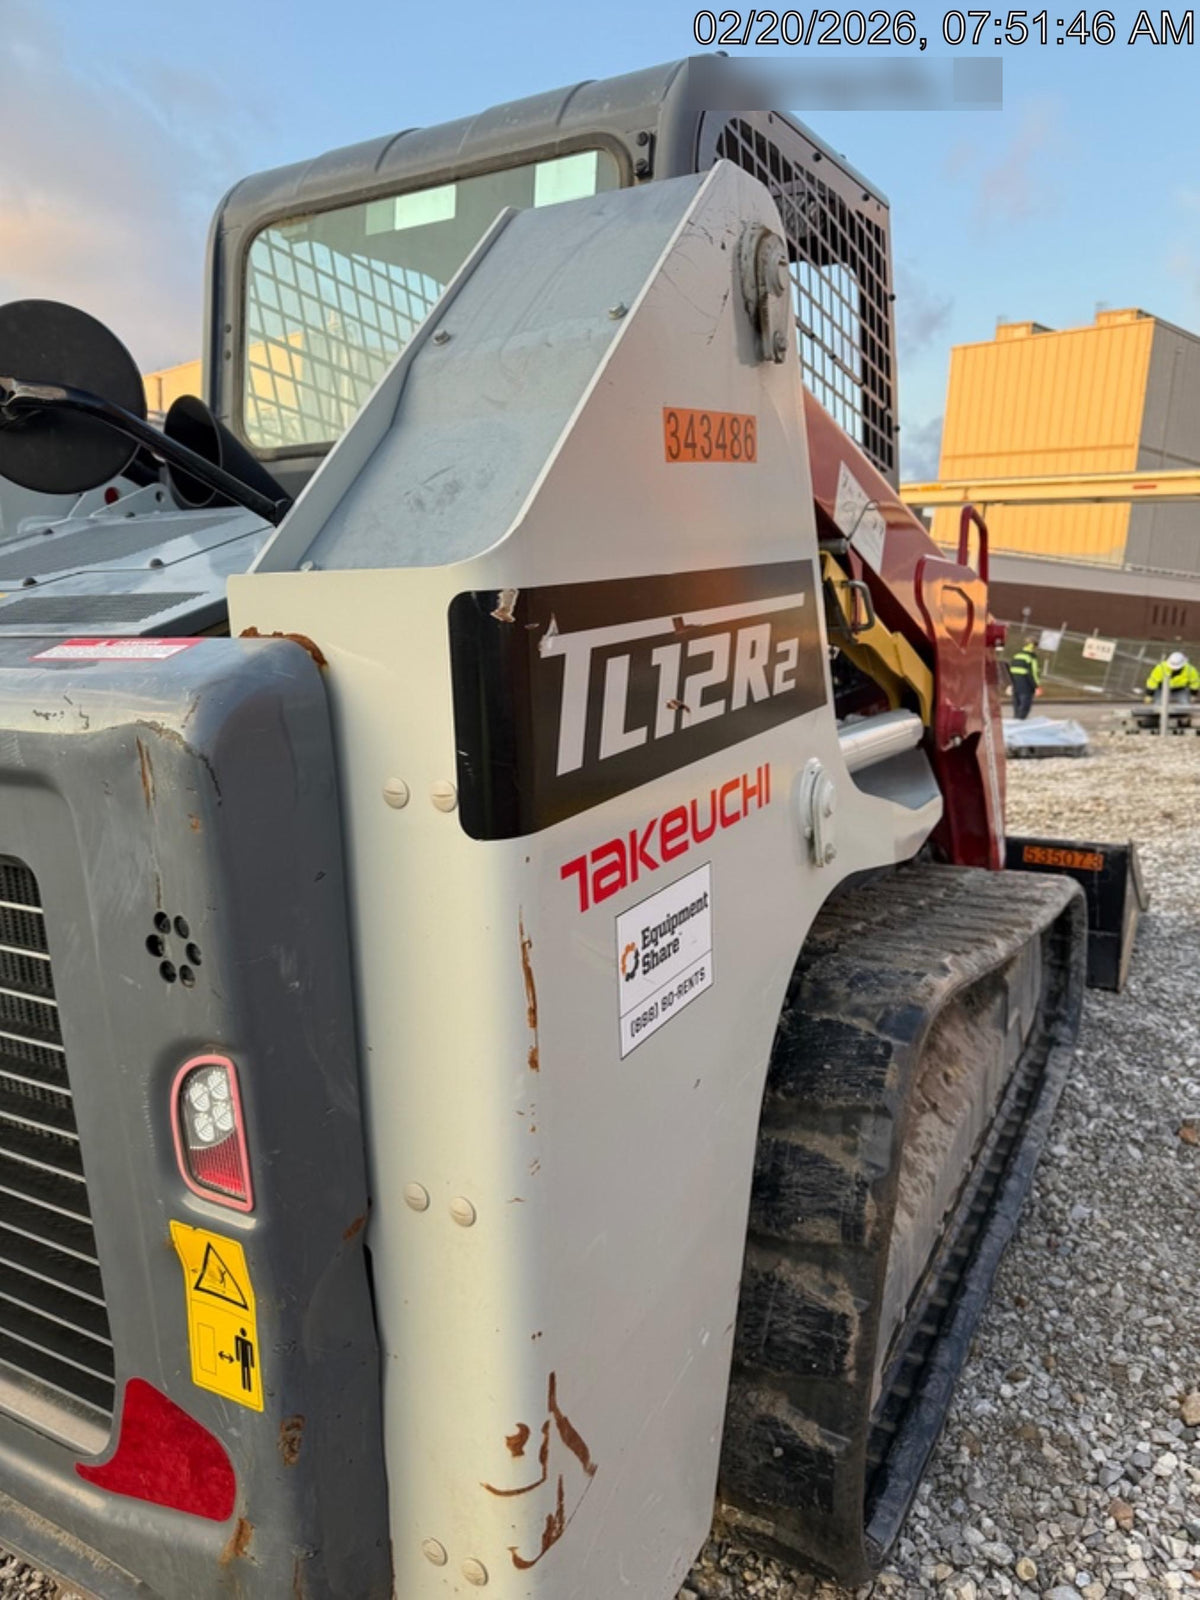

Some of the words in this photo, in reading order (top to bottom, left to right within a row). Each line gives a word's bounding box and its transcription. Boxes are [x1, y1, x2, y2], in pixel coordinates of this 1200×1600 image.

[667, 411, 755, 461] 343486
[539, 592, 805, 777] TL12R2
[560, 762, 770, 913] TAKEUCHI
[1025, 848, 1102, 869] 535073
[641, 891, 709, 950] Equipment
[642, 937, 681, 976] Share
